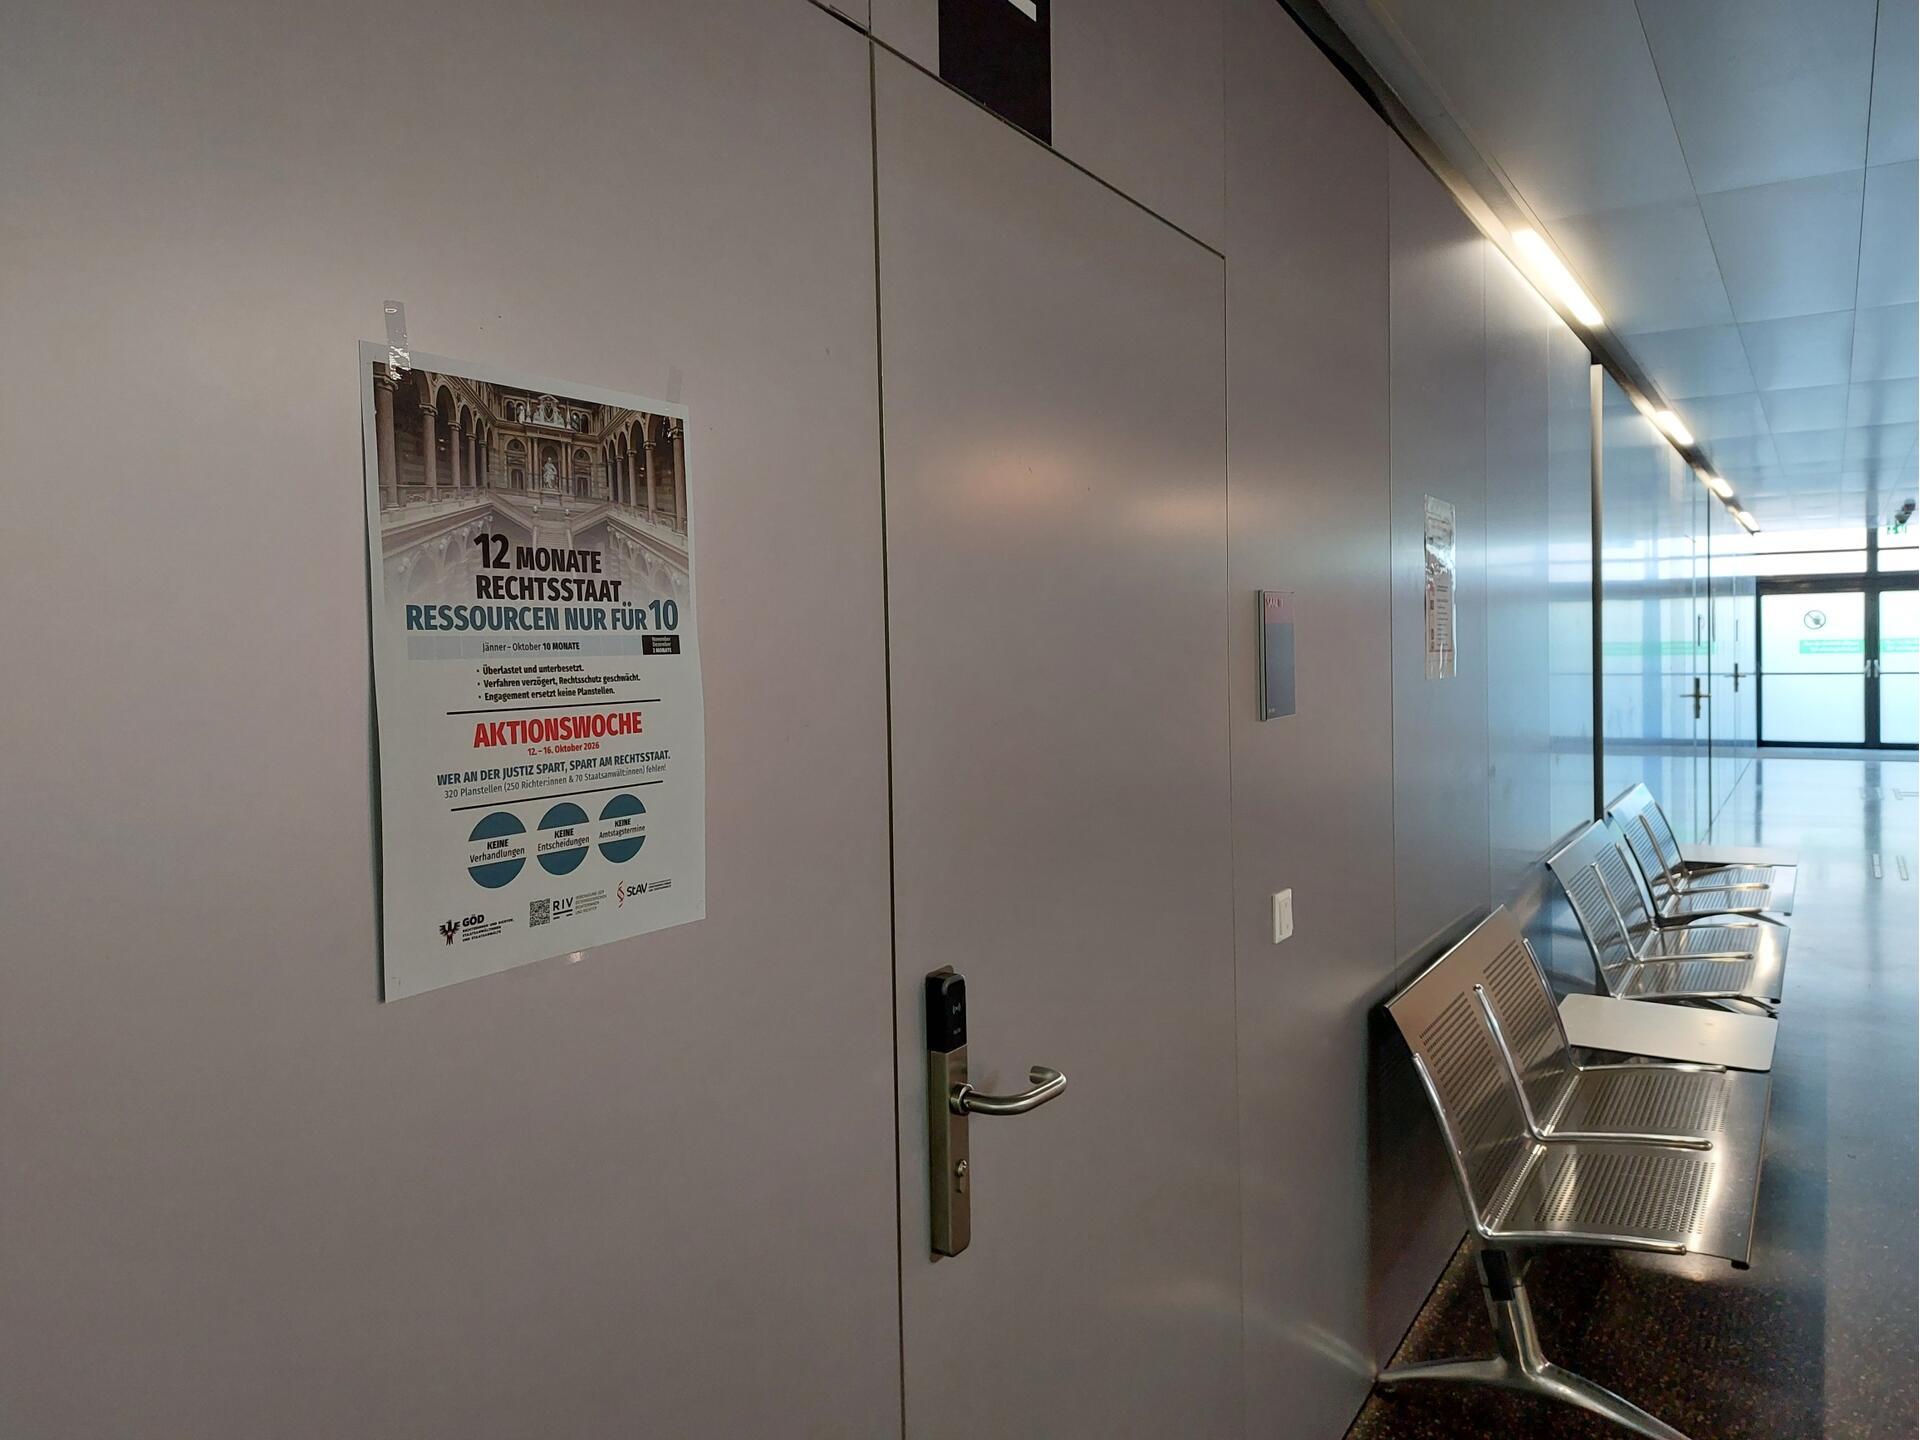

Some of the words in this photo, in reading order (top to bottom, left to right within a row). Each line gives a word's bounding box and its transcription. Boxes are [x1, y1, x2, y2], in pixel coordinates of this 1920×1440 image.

[473, 533, 510, 569] 12
[516, 546, 602, 573] MONATE
[476, 575, 622, 602] RECHTSSTAAT
[406, 604, 559, 630] RESSOURCEN
[565, 607, 607, 630] NUR
[611, 601, 648, 630] FÜR
[648, 599, 679, 631] 10
[482, 642, 506, 653] Jänner
[512, 642, 541, 651] Oktober
[542, 642, 551, 651] 10
[552, 642, 580, 650] MONATE
[482, 664, 522, 675] Überlastet
[523, 664, 538, 674] und
[538, 664, 584, 673] unterbesetzt.
[483, 678, 520, 688] Verfahren
[521, 677, 558, 686] verzögert,
[558, 675, 602, 685] Rechtsschutz
[603, 673, 641, 683] geschwächt.
[484, 692, 530, 702] Engagement
[531, 690, 556, 698] ersetzt
[557, 689, 577, 697] keine
[577, 687, 615, 696] Planstellen.
[473, 711, 643, 748] AKTIONSWOCHE
[527, 747, 538, 756] 12.
[554, 742, 582, 754] Oktober
[583, 742, 600, 750] 2026
[437, 773, 461, 786] WER
[463, 771, 478, 783] AN
[480, 769, 501, 782] DER
[502, 765, 535, 780] JUSTIZ
[536, 761, 568, 777] SPART,
[570, 758, 598, 772] SPART
[599, 756, 613, 767] AM
[614, 750, 671, 765] RECHTSSTAAT.
[444, 789, 459, 799] 320
[460, 783, 503, 796] Planstellen
[503, 780, 520, 793] (250
[521, 775, 567, 790] Richter:innen
[568, 776, 574, 784] &
[575, 775, 583, 783] 70
[614, 819, 632, 827] KEINE
[554, 828, 575, 839] KEINE
[598, 825, 646, 839] Amtstagstermine
[486, 839, 509, 851] KEINE
[537, 836, 590, 852] Entscheidungen
[470, 847, 526, 863] Verhandlungen
[626, 883, 649, 897] StAV
[552, 897, 574, 912] RIV
[462, 913, 485, 928] GÖD
